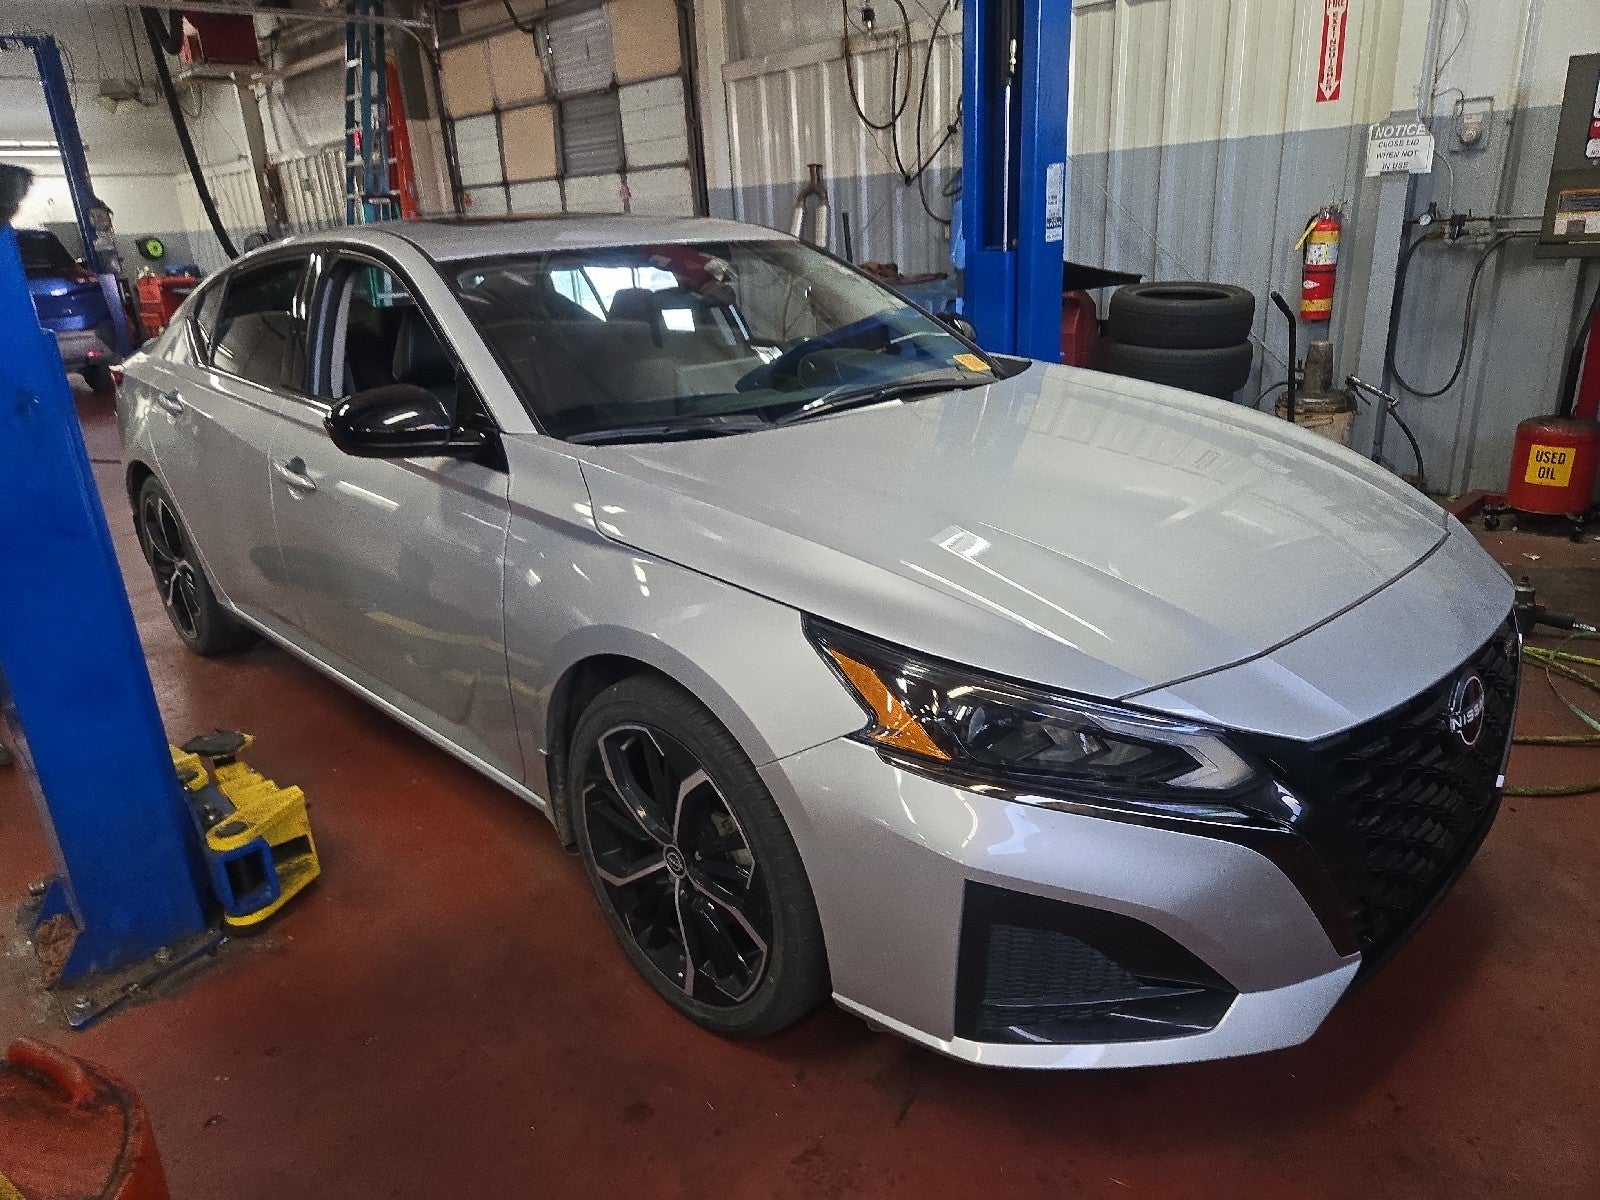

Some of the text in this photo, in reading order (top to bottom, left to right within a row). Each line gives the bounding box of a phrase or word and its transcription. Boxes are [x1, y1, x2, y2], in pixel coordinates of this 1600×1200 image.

[1326, 11, 1338, 91] EXTINGUISHER
[1375, 123, 1426, 138] NOTICE
[1378, 140, 1404, 148] CLOSE
[1376, 151, 1400, 159] WHEN
[1382, 162, 1391, 170] IN
[1535, 450, 1566, 465] USED
[1538, 466, 1556, 480] OIL
[1451, 699, 1483, 731] NISS
